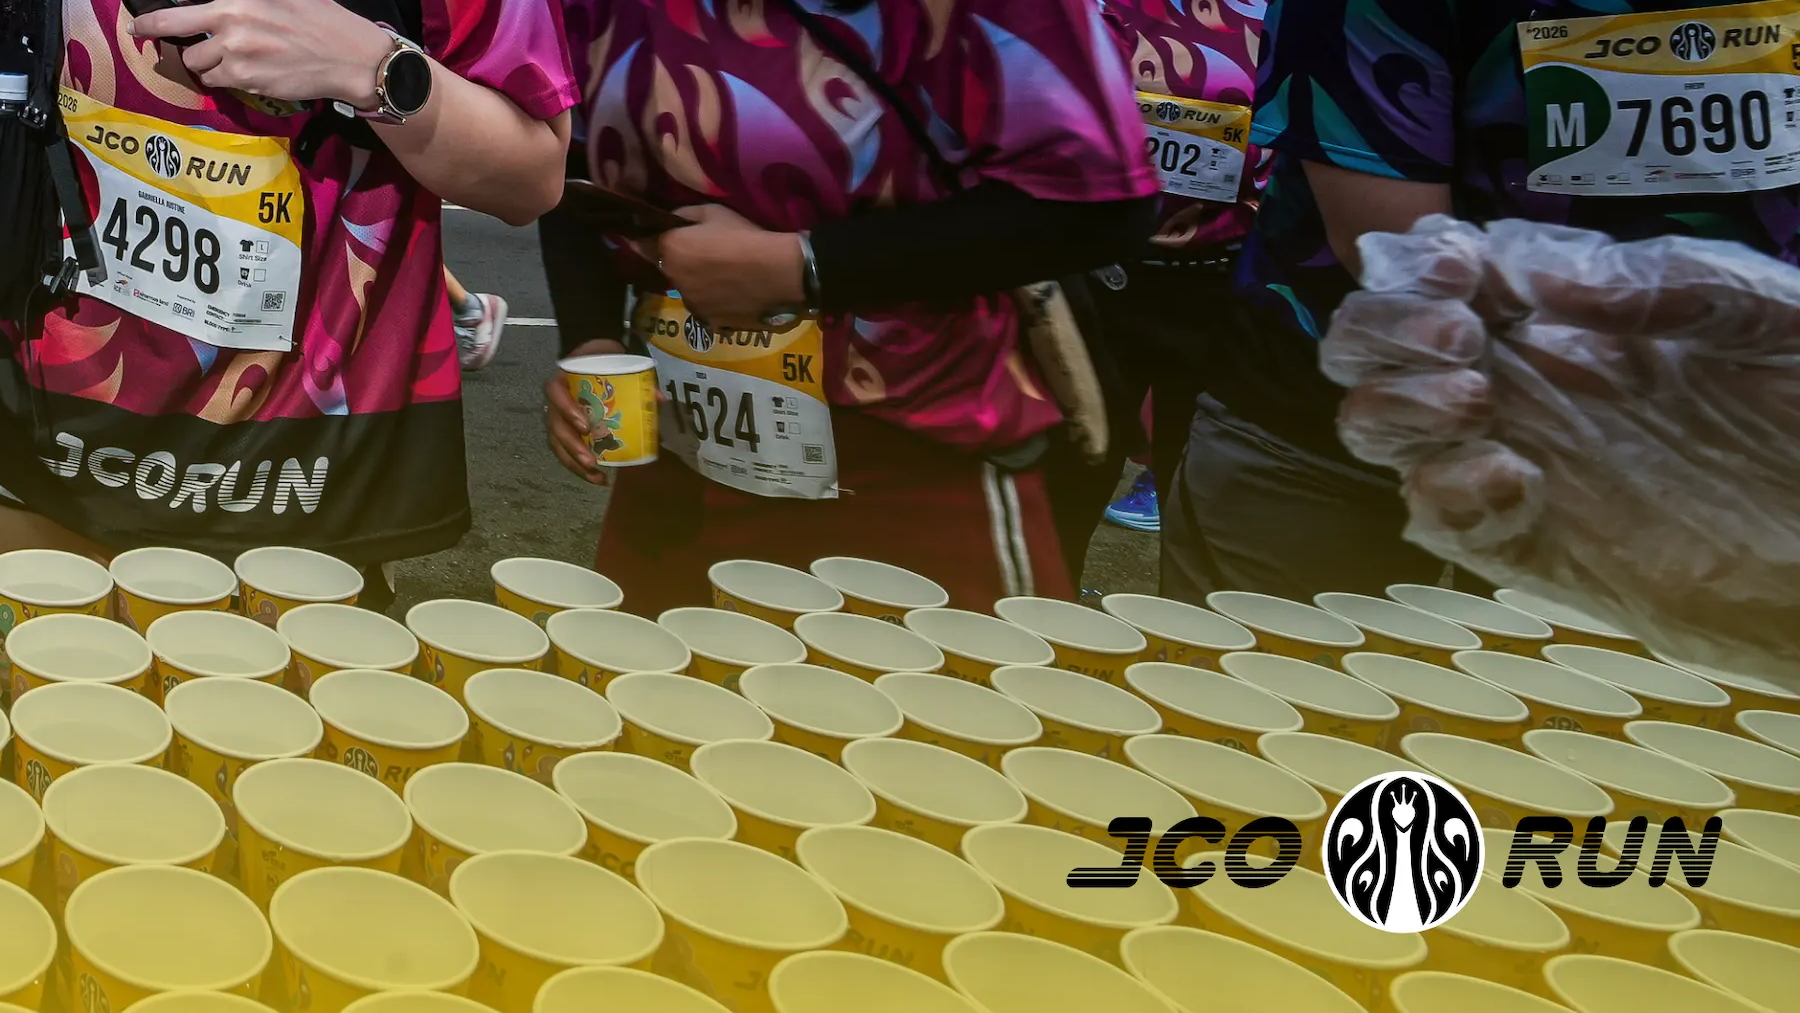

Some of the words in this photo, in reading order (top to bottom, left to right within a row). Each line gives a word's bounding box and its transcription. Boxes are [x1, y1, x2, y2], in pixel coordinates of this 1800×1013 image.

[1533, 25, 1569, 40] 2026
[1584, 36, 1662, 59] JCO
[1722, 24, 1781, 48] RUN
[57, 93, 79, 113] 2026
[1184, 109, 1222, 125] RUN
[1223, 127, 1244, 144] 5K
[1545, 102, 1586, 148] M
[1616, 90, 1773, 157] 7690
[85, 125, 140, 155] JCO
[185, 155, 252, 186] RUN
[257, 191, 294, 224] 5K
[102, 196, 222, 295] 4298
[254, 254, 268, 262] Size
[237, 280, 252, 288] Drink
[782, 353, 815, 384] 5K
[666, 379, 761, 454] 1524
[39, 431, 330, 515] JCORUN
